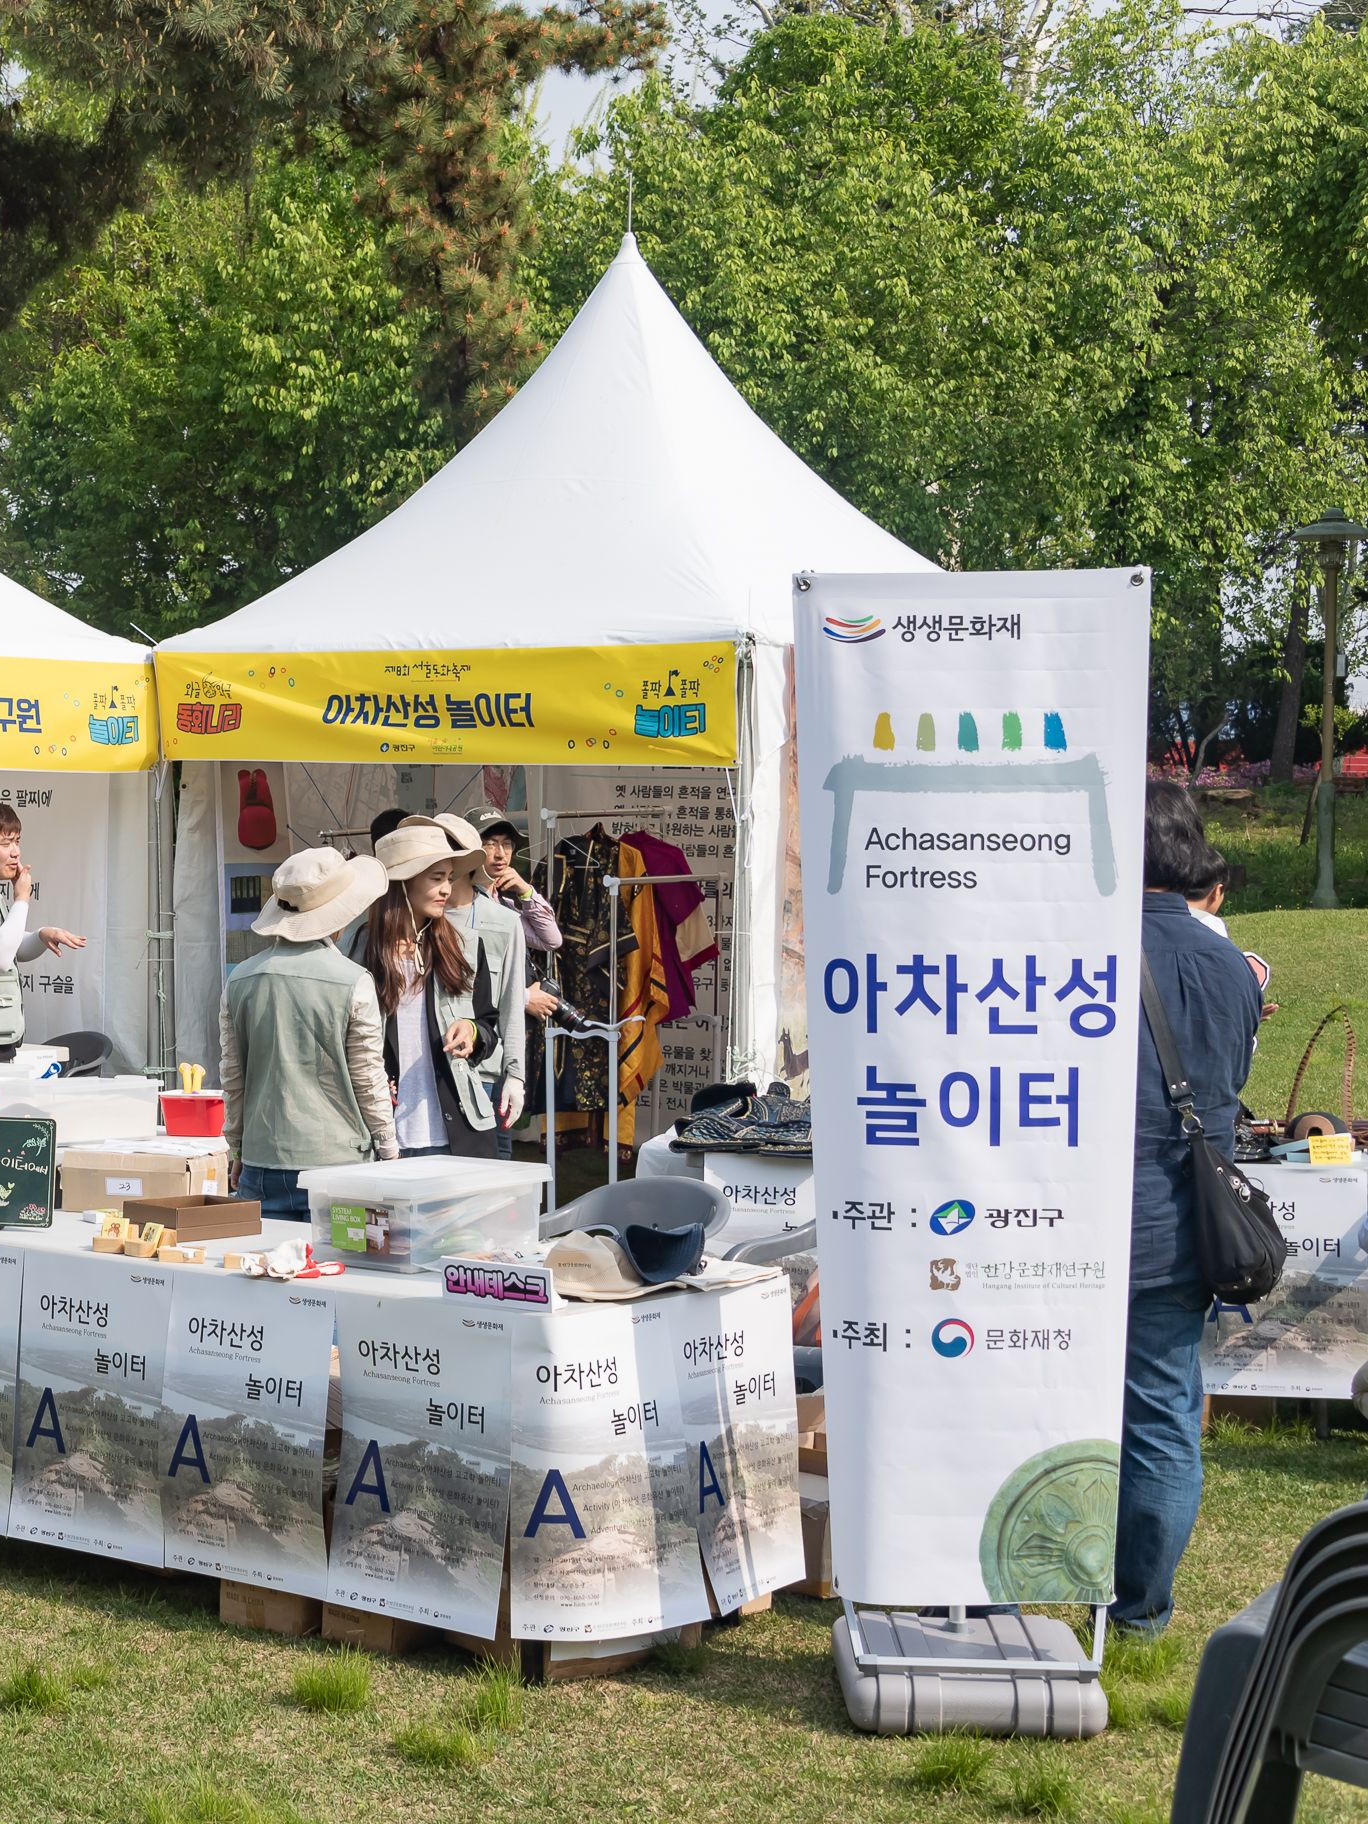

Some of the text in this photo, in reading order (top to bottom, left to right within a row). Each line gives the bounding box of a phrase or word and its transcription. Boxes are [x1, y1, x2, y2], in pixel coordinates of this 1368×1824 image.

[892, 613, 1022, 642] 생생문화재
[384, 661, 472, 682] 제8회 서울동화축제
[92, 693, 137, 712] 폴짝 폴짝
[184, 681, 201, 700] 와글
[642, 678, 700, 699] 폴짝 폴짝
[177, 702, 243, 735] 동화나라
[322, 692, 535, 729] 아차산성 놀이터
[634, 703, 706, 738] 놀이터
[87, 714, 140, 746] 놀이터
[392, 743, 416, 752] 광진구
[15, 789, 53, 808] 팔찌에
[615, 784, 712, 800] 옛 사람들의 흔적을
[676, 805, 710, 820] 흔적을
[864, 827, 1071, 856] Achasanseong
[866, 865, 978, 889] Fortress
[38, 974, 75, 995] 구슬을
[823, 953, 1118, 1038] 아차산성
[662, 1045, 695, 1061] 유물을
[665, 1063, 710, 1079] 깨지거나
[856, 1065, 1080, 1148] 놀이터
[722, 1184, 797, 1206] 아차산성
[332, 1206, 352, 1215] SYSTEM
[842, 1200, 1065, 1231] 주관 광진구
[444, 1263, 548, 1304] 안내데스크
[981, 1260, 1106, 1279] 한강문화재연구원
[982, 1282, 1012, 1290] Hangang
[1079, 1282, 1106, 1290] Heritage
[40, 1294, 109, 1328] 아차산성
[476, 1320, 504, 1331] 생생문화재
[188, 1317, 264, 1352] 아차산성
[683, 1330, 745, 1366] 아차산성
[840, 1320, 1072, 1352] 주최 문화재청
[94, 1348, 146, 1381] 놀이터
[188, 1346, 261, 1363] Achasanseong Fortress
[358, 1339, 441, 1376] 아차산성
[362, 1369, 441, 1388] Achasanseong Fortress
[535, 1356, 619, 1393] 아차산성
[733, 1371, 777, 1406] 놀이터
[245, 1373, 303, 1407] 놀이터
[539, 1389, 620, 1405] Achasanseong Fortress
[25, 1387, 67, 1454] A
[426, 1397, 485, 1434] 놀이터
[611, 1400, 660, 1436] 놀이터
[167, 1413, 212, 1484] A
[208, 1452, 232, 1465] Activity
[344, 1439, 391, 1513] A
[390, 1480, 414, 1493] Activity
[699, 1440, 726, 1514] A
[523, 1469, 587, 1540] A
[583, 1503, 611, 1513] Activity
